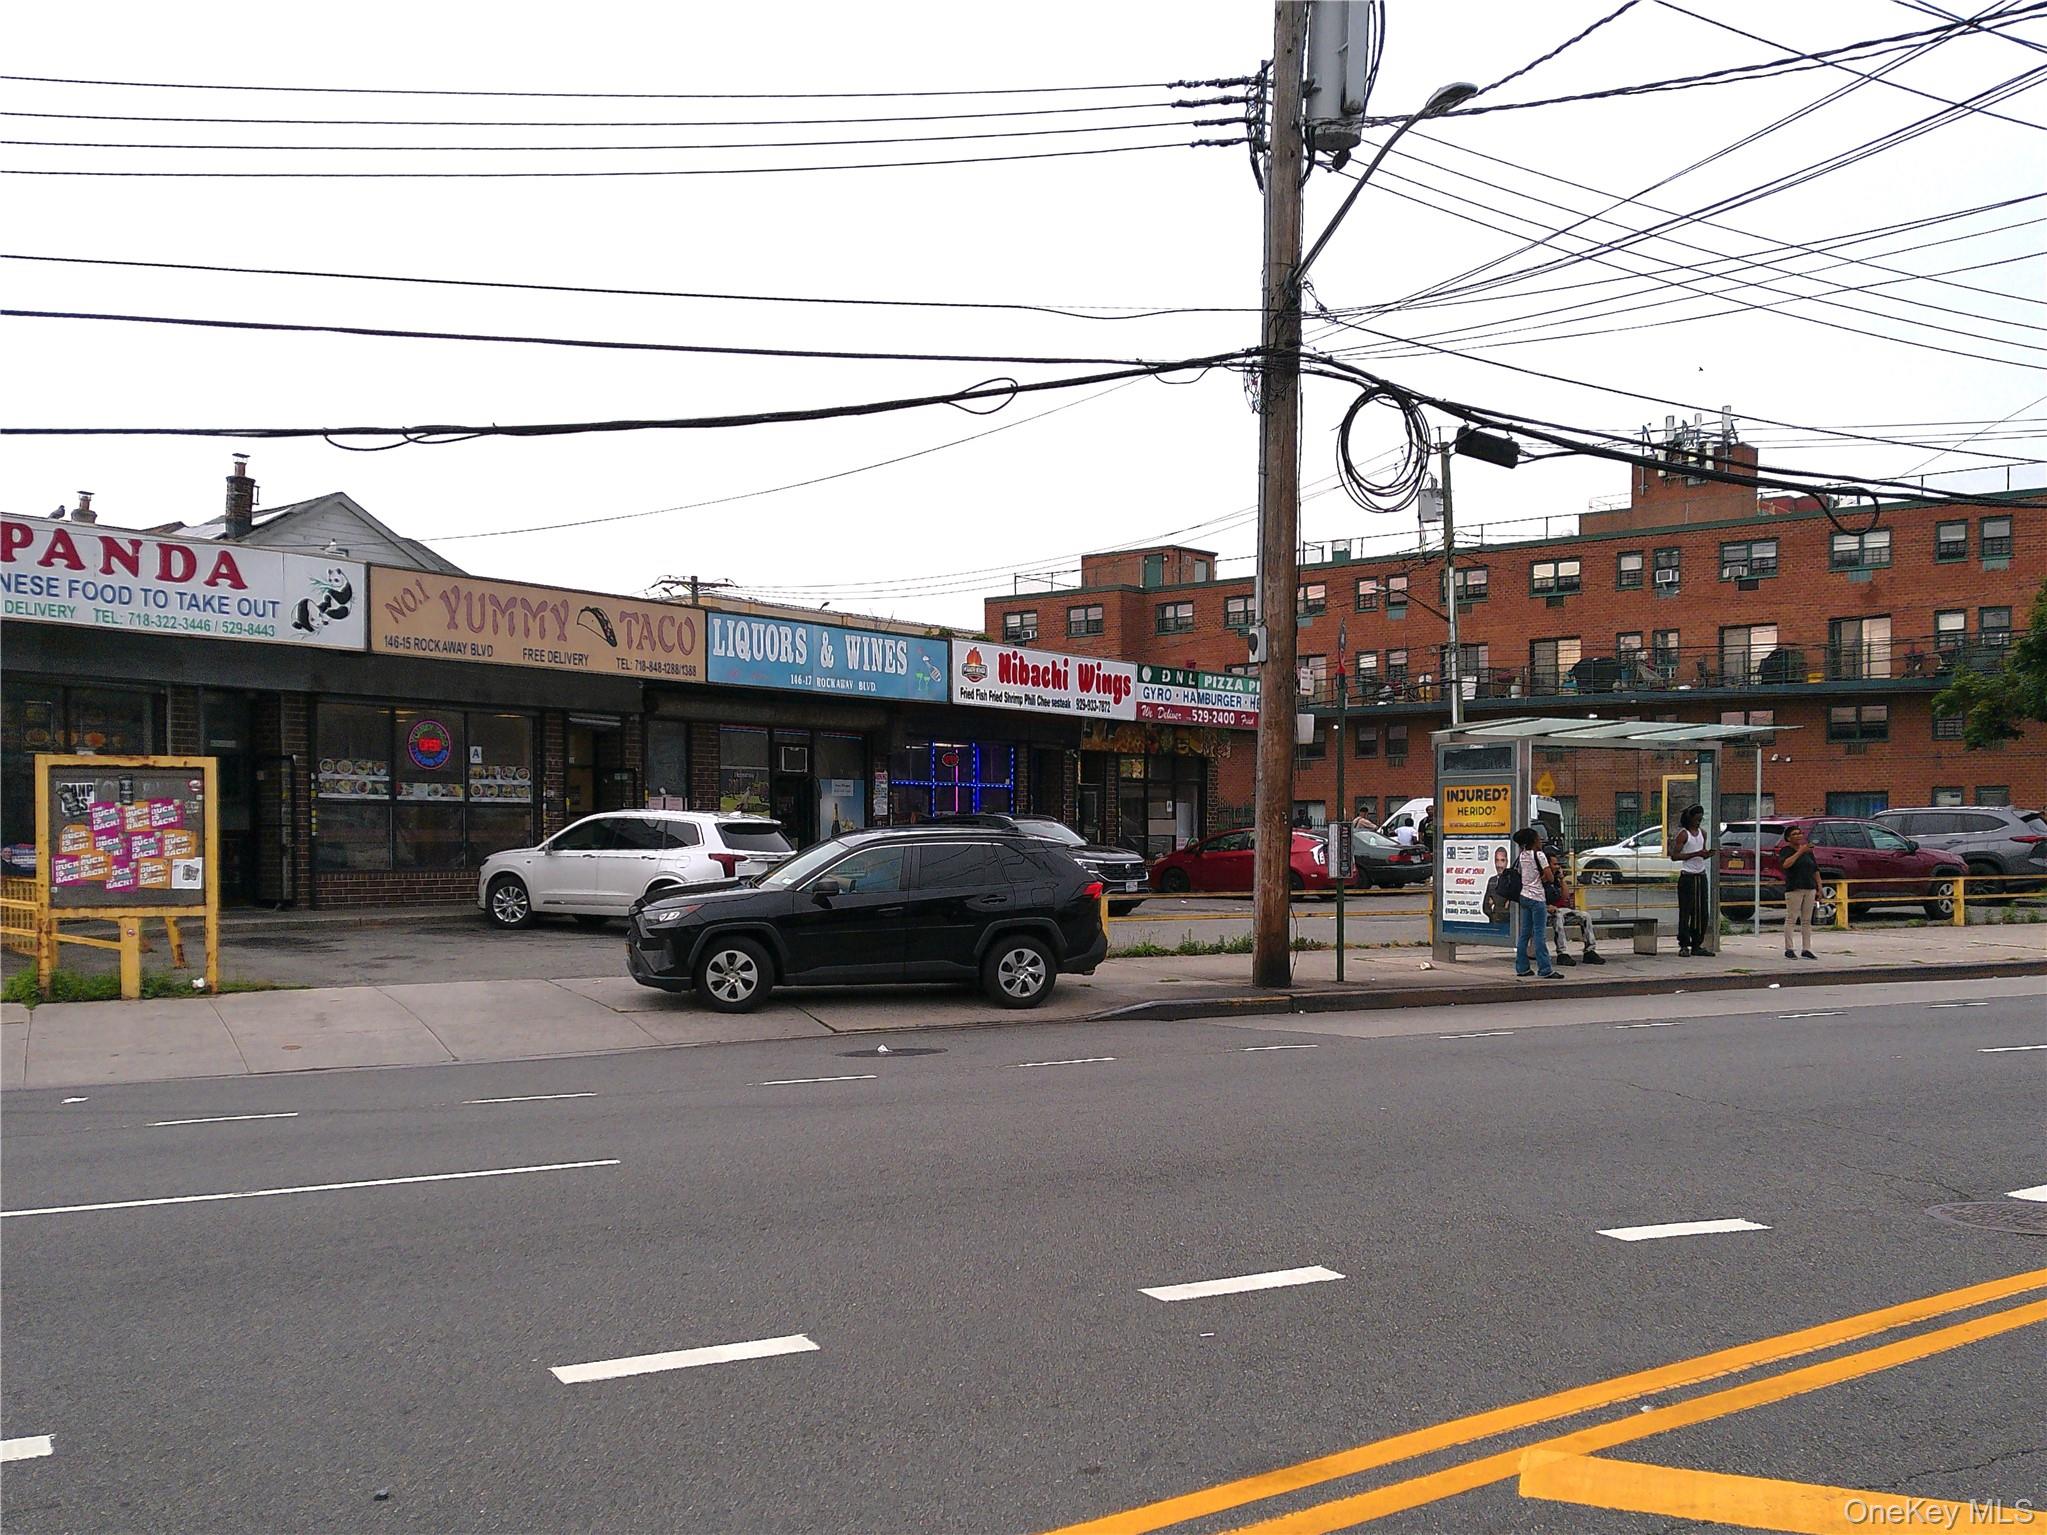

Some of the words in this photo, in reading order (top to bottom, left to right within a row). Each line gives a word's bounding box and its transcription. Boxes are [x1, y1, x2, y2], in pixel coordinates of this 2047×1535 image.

[0, 521, 248, 590] PANDA
[67, 579, 132, 606] FOOD
[139, 587, 168, 609] TO
[175, 591, 230, 615] TAKE
[237, 597, 281, 618] OUT
[4, 599, 77, 619] DELIVERY
[93, 608, 123, 625] TEL:
[128, 612, 211, 632] 718-322-3446
[440, 585, 569, 642] YUMMY
[619, 610, 696, 656] TACO
[384, 634, 411, 651] 146-15
[413, 637, 468, 656] ROCKAWAY
[470, 643, 494, 658] BLVD
[713, 618, 808, 666] LIQUORS
[820, 631, 835, 668] &
[845, 634, 908, 676] WINES
[522, 647, 546, 664] FREE
[547, 651, 589, 668] DELIVERY
[616, 656, 634, 672] TEL:
[790, 673, 812, 687] 146-17
[816, 676, 854, 691] ROCKAWAY
[998, 650, 1069, 691] Hibachi
[1077, 662, 1131, 705] Wings
[1204, 675, 1244, 692] PIZZA
[960, 686, 974, 700] Fried
[975, 688, 988, 702] Fish
[989, 689, 1003, 703] Fried
[1004, 691, 1024, 707] Shrimp
[1143, 686, 1172, 702] GYRO
[1183, 689, 1242, 709] HAMBURGER
[1157, 706, 1182, 721] Deliver
[472, 747, 480, 759] A
[1446, 788, 1509, 803] INJURED?
[1457, 806, 1497, 817] HERIDO?
